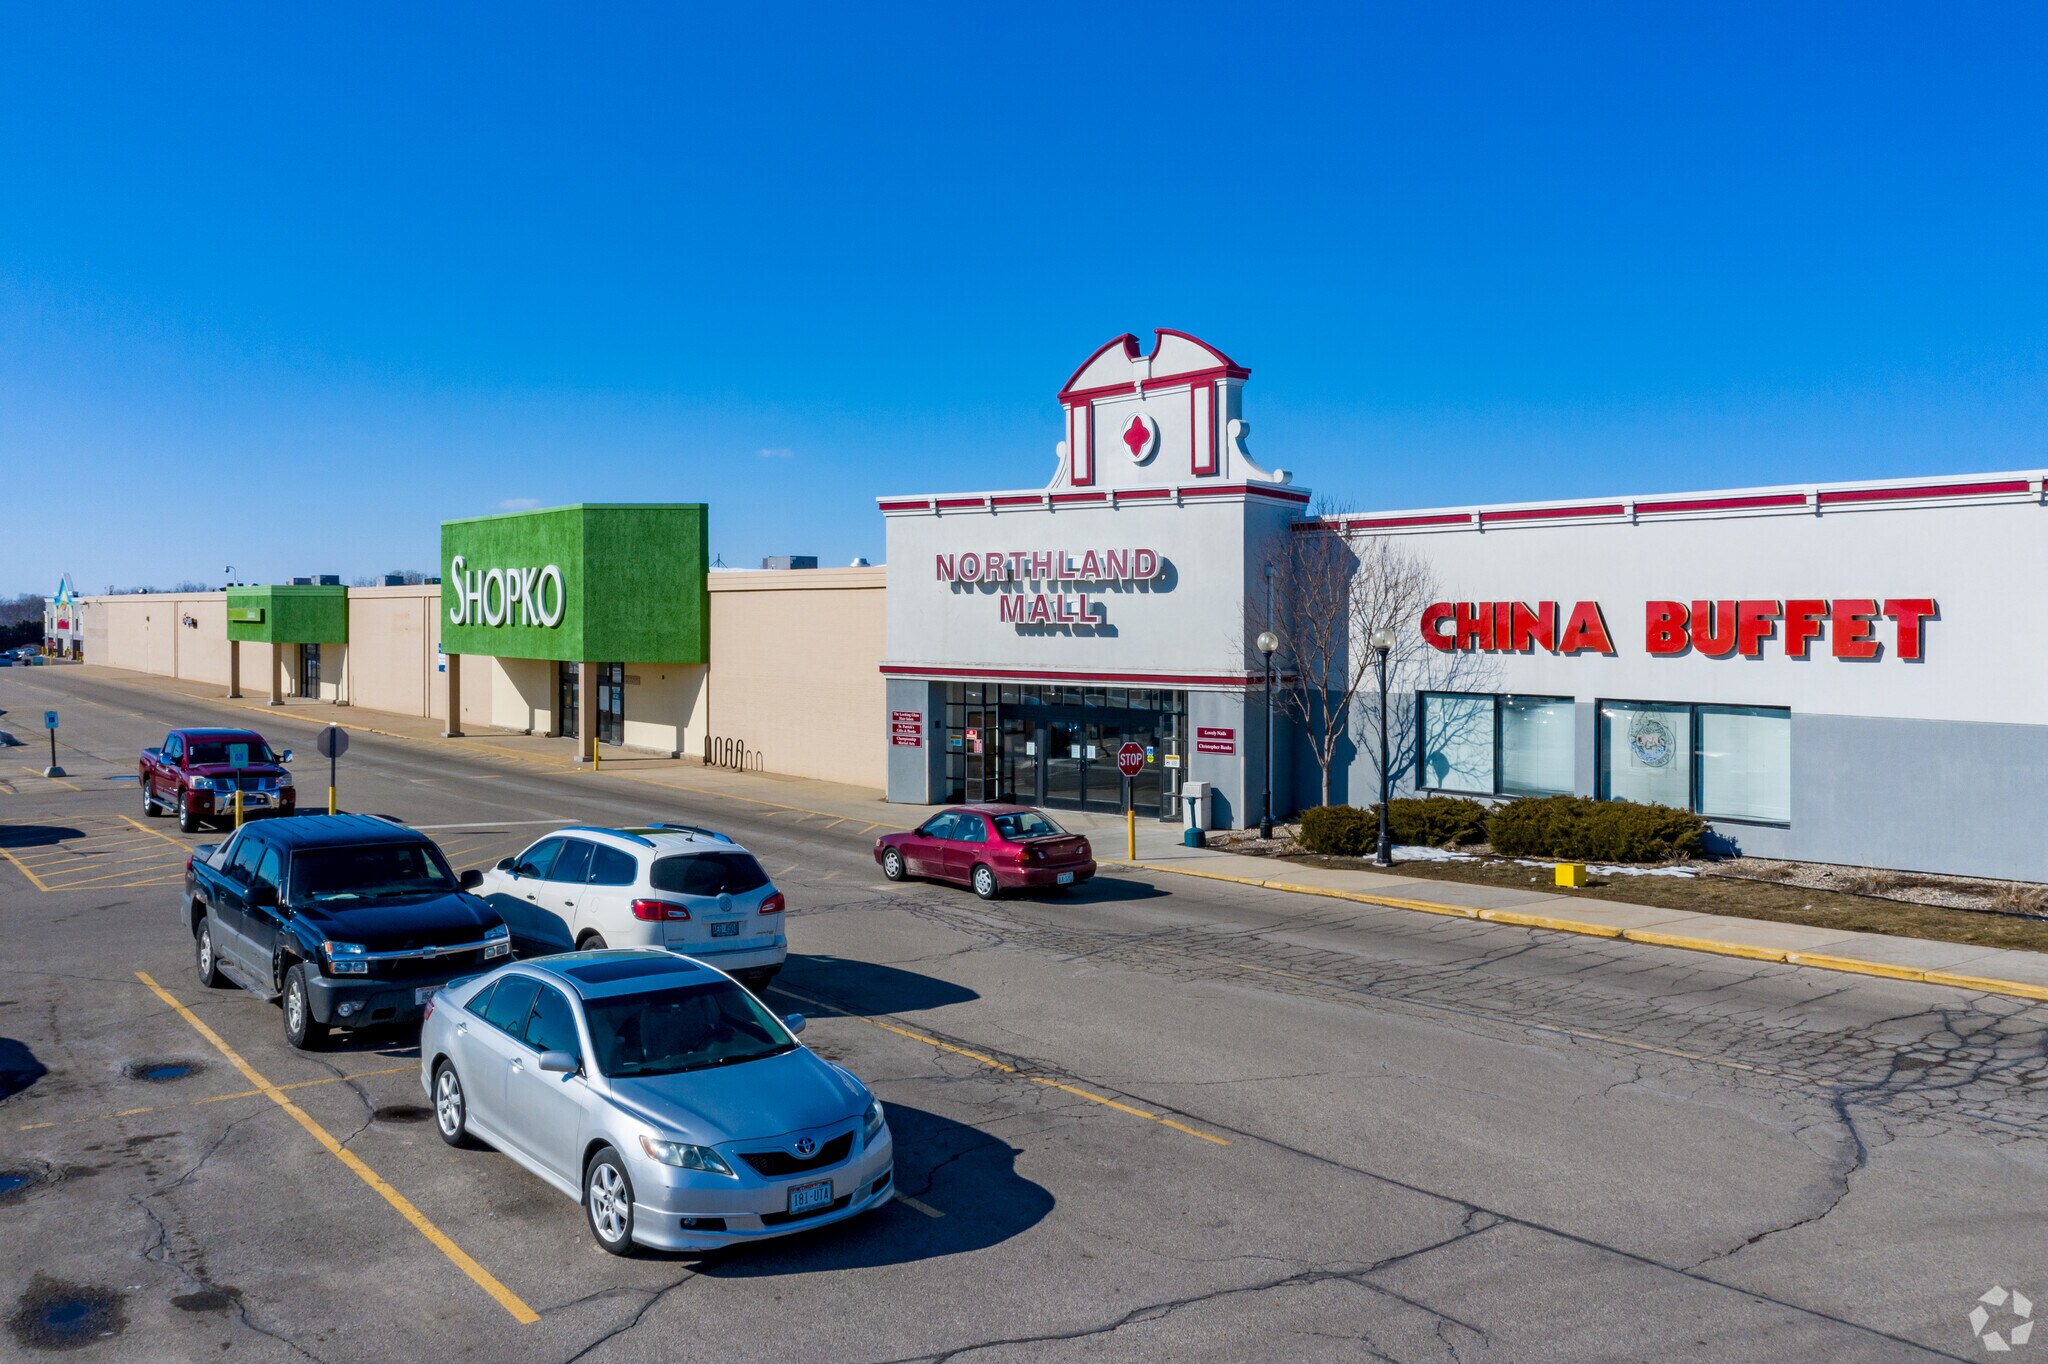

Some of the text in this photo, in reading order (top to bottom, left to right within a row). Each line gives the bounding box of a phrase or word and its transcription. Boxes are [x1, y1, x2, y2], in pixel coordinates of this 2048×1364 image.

[935, 548, 1162, 582] NORTHLAND
[450, 555, 566, 628] SHOPKO
[1000, 593, 1102, 624] MALL
[1420, 599, 1938, 659] CHINA BUFFET
[1120, 753, 1142, 766] STOP
